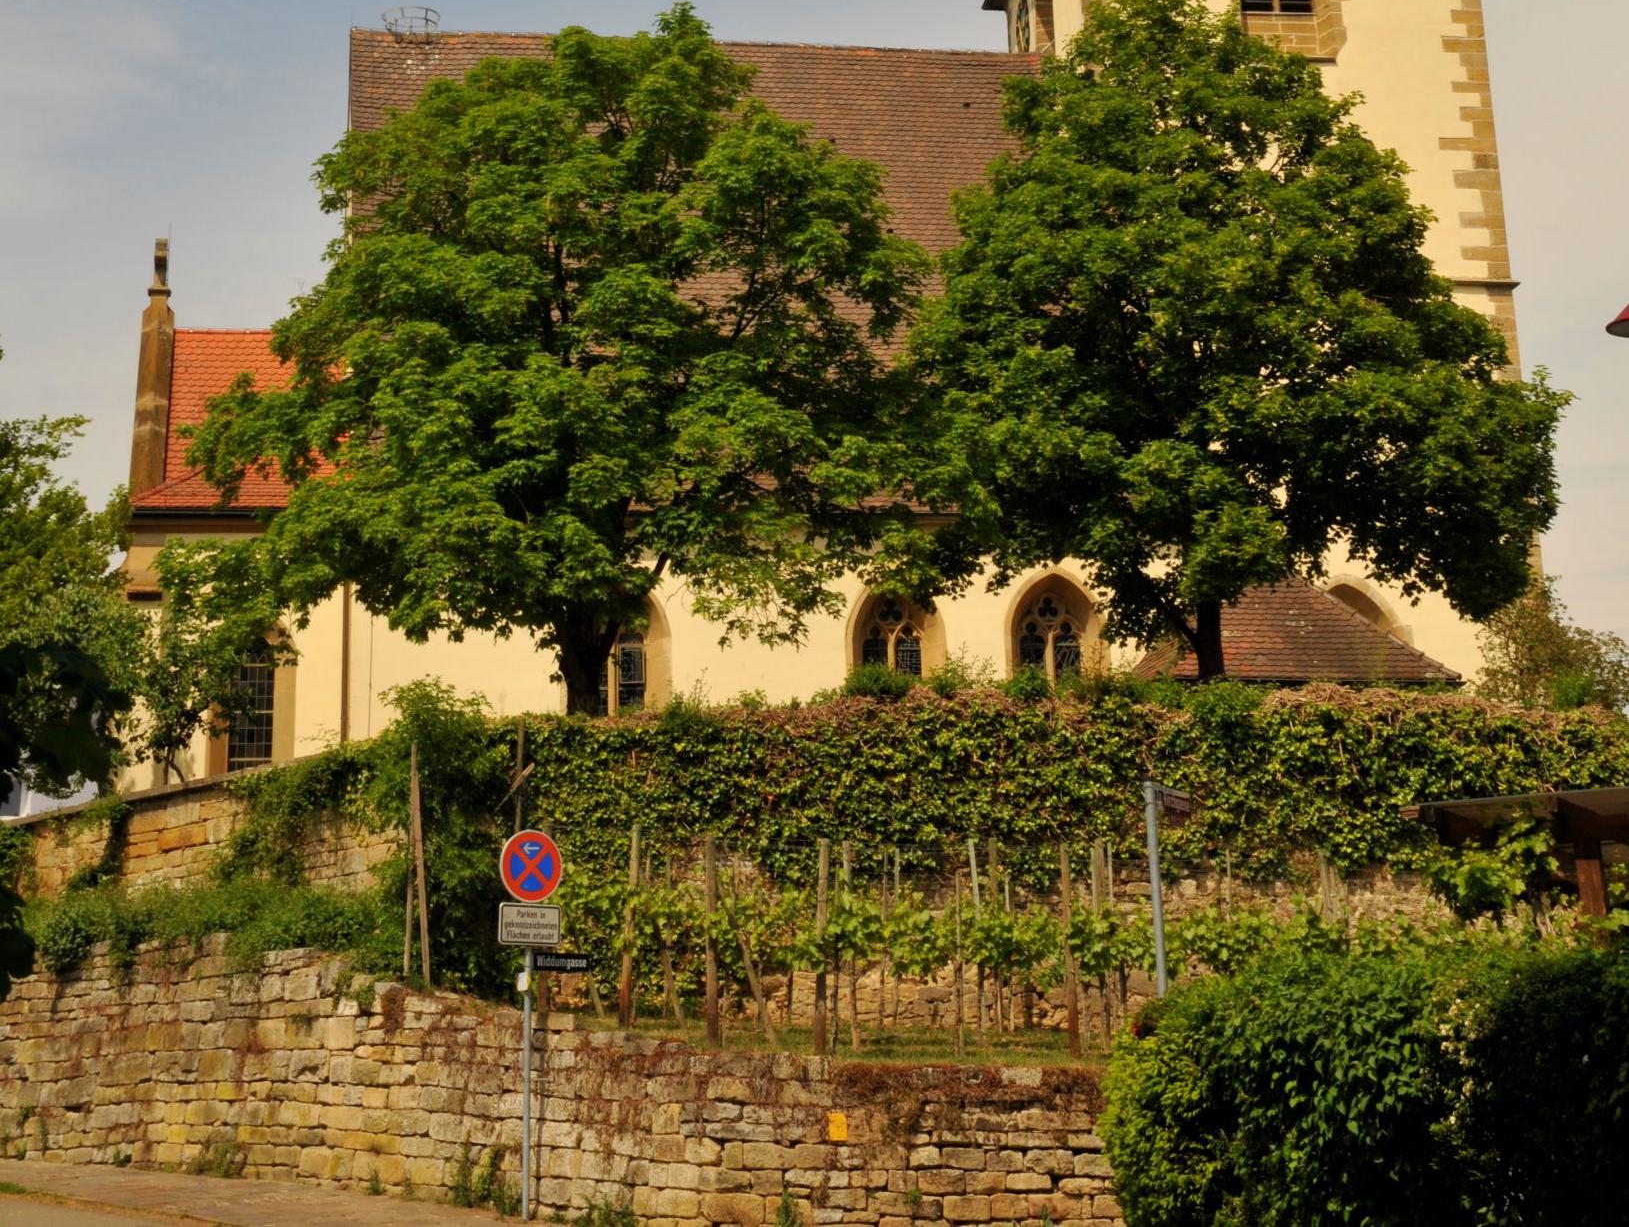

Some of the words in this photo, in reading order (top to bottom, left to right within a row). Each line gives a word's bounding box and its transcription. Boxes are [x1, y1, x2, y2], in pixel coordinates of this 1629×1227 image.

[516, 909, 537, 919] Parken
[537, 911, 546, 919] in
[504, 920, 558, 930] gekennzeichneten
[506, 930, 530, 939] Flächen
[532, 932, 554, 941] erlaubt
[536, 955, 587, 970] Widdumgasse
